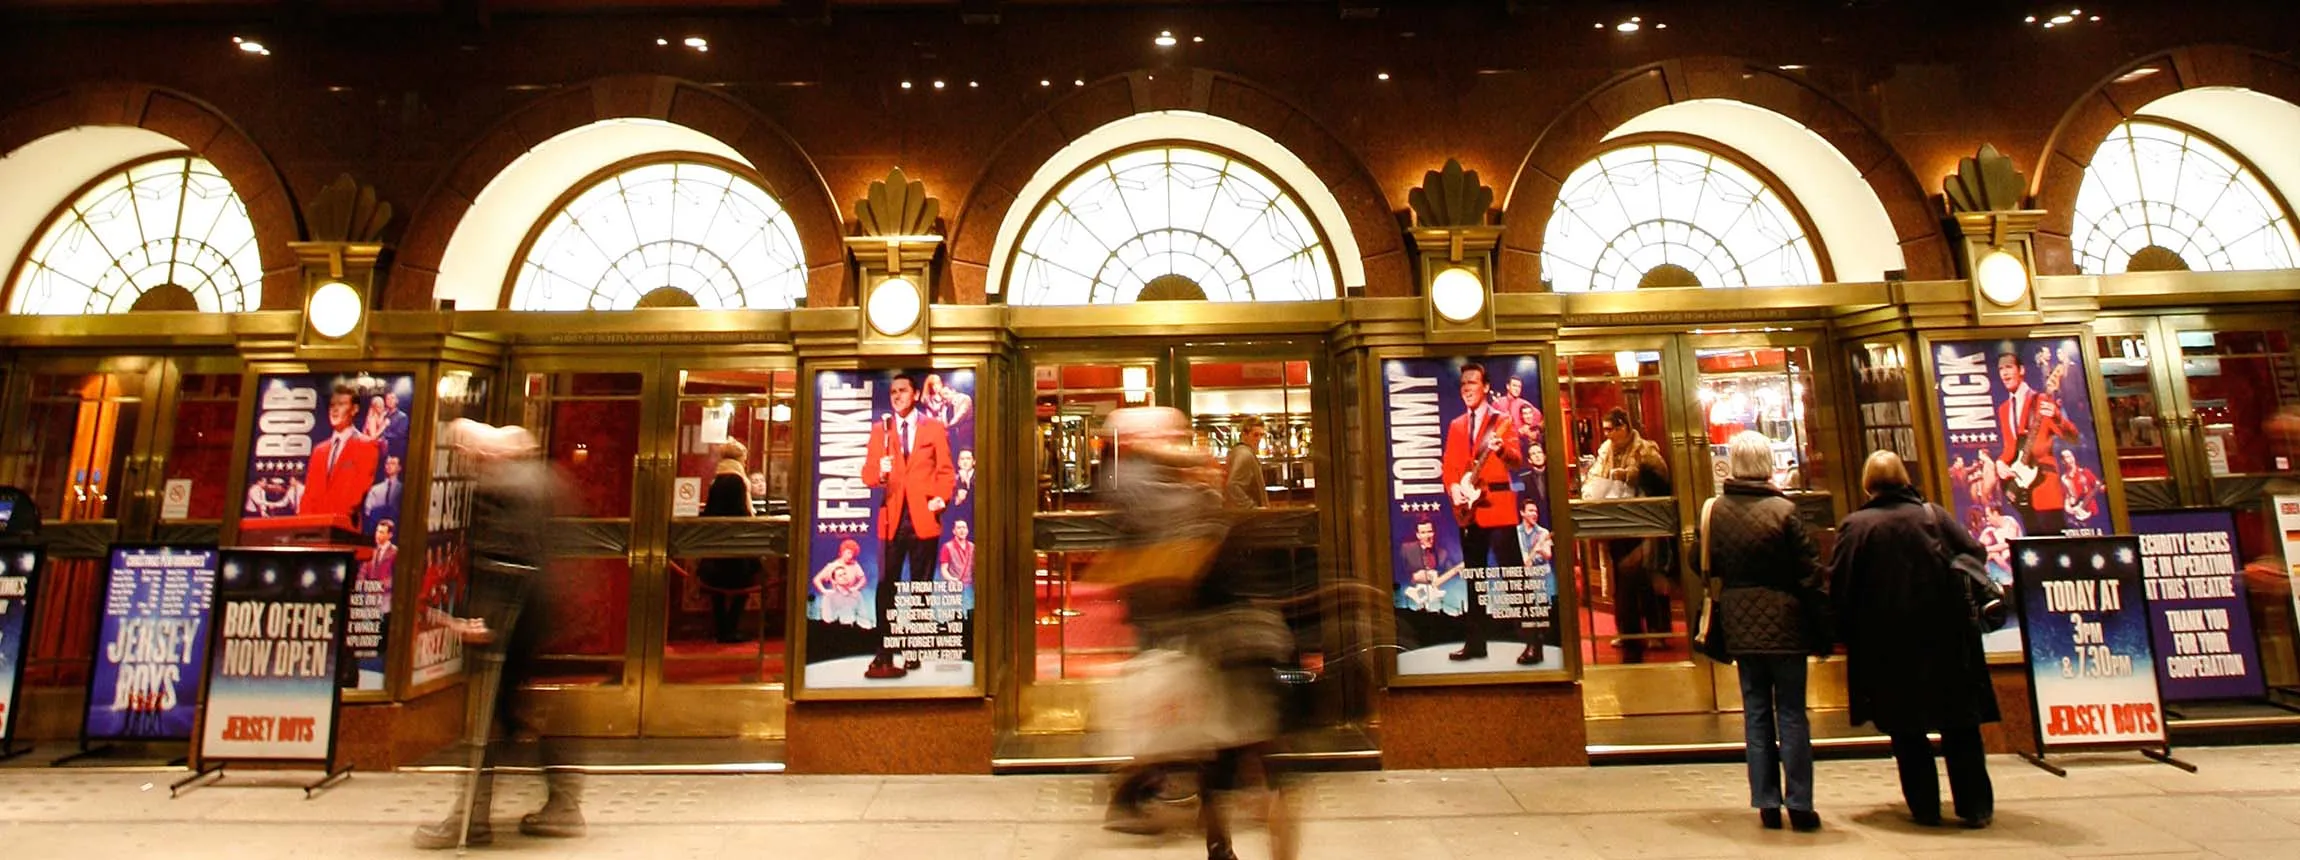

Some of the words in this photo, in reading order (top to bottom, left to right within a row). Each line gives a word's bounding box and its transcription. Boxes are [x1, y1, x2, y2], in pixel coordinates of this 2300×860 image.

[1938, 352, 1997, 430] NICK
[256, 387, 317, 457] BOB
[1388, 373, 1445, 500] TOMMY
[818, 381, 873, 519] FRANKIE
[2139, 533, 2186, 556] ECURITY
[2186, 532, 2231, 554] CHECKS
[1485, 567, 1500, 578] GOT
[1501, 566, 1524, 578] THREE
[2159, 555, 2173, 577] IN
[2173, 554, 2236, 577] OPERATION
[911, 581, 932, 593] FROM
[933, 581, 947, 592] THE
[948, 581, 963, 592] OLD
[1509, 580, 1523, 591] THE
[2042, 580, 2096, 612] TODAY
[2101, 579, 2121, 611] AT
[2159, 578, 2187, 600] THIS
[2187, 576, 2236, 599] THEATRE
[925, 594, 941, 606] YOU
[942, 594, 962, 606] COME
[1524, 593, 1536, 604] UP
[223, 601, 266, 638] BOX
[267, 602, 336, 639] OFFICE
[886, 609, 897, 620] UP
[1492, 607, 1522, 619] BECOME
[1522, 607, 1529, 618] A
[2165, 609, 2207, 632] THANK
[2204, 608, 2230, 631] YOU
[889, 622, 904, 634] THE
[905, 622, 938, 634] PROMISE
[947, 622, 963, 634] YOU
[2070, 613, 2104, 645] 3PM
[107, 617, 200, 664] JERSEY
[883, 636, 907, 649] DON'T
[907, 636, 935, 648] FORGET
[936, 635, 963, 648] WHERE
[2173, 632, 2200, 655] FOR
[2197, 632, 2231, 654] YOUR
[223, 639, 272, 676] NOW
[274, 640, 328, 677] OPEN
[901, 650, 917, 662] YOU
[918, 650, 940, 661] CAME
[2166, 654, 2246, 678] COOPERATION
[112, 663, 180, 711] BOYS
[222, 716, 275, 741] JERSEY
[278, 716, 316, 742] BOYS
[2047, 704, 2108, 737] JERSEY
[2111, 702, 2159, 735] BOYS
